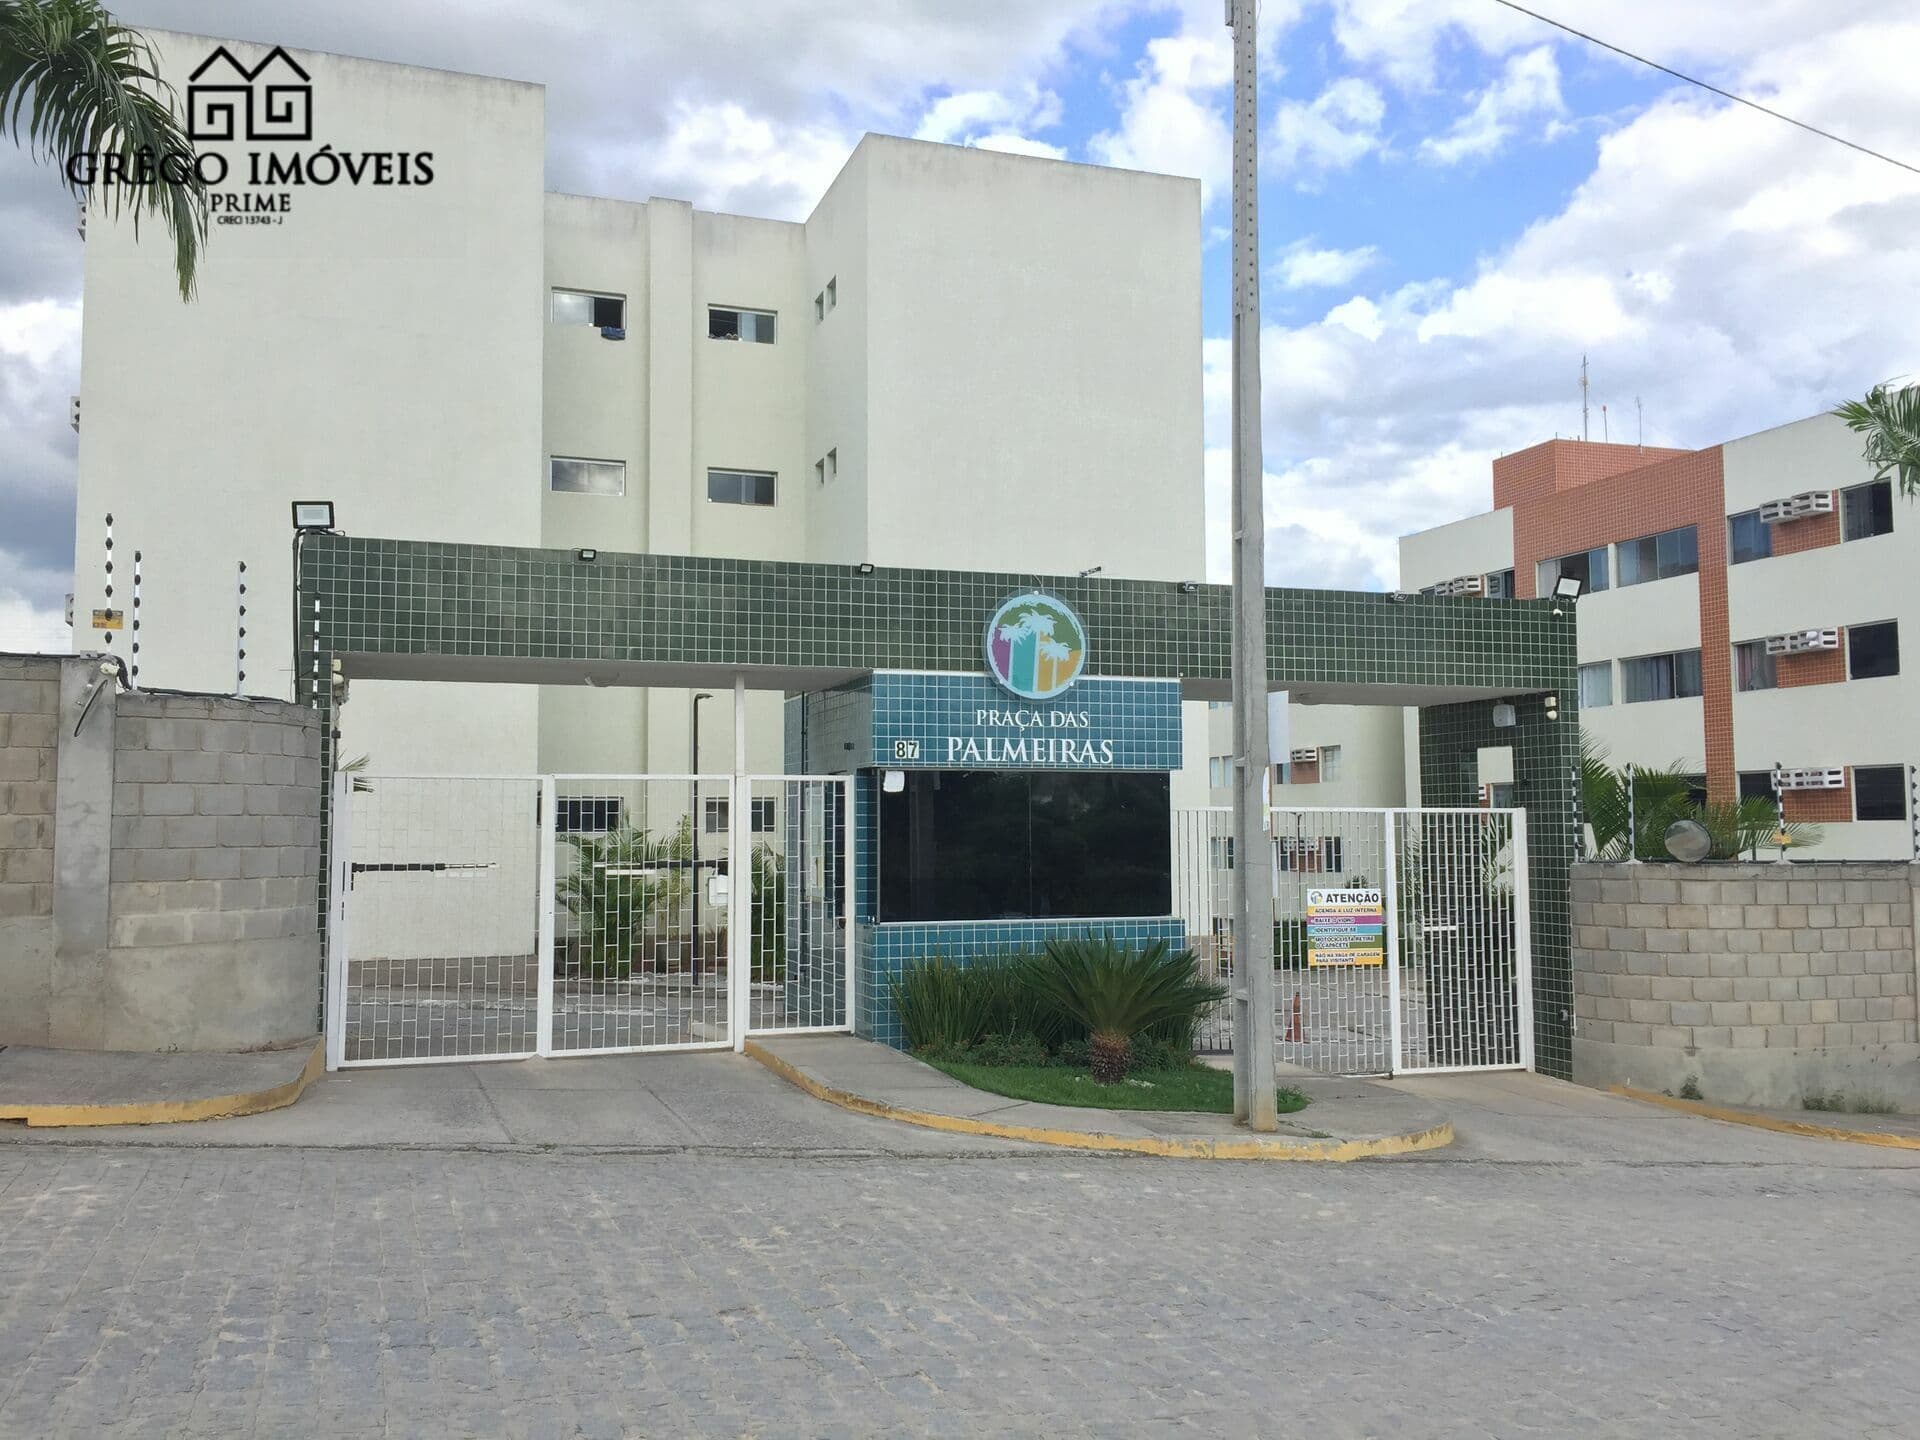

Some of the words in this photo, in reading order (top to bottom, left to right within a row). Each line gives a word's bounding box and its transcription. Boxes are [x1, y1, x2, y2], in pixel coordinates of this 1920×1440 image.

[976, 709, 1044, 730] PRAÇA
[1050, 711, 1089, 728] DAS
[895, 741, 918, 759] 87
[946, 737, 1113, 764] PALMEIRAS
[1326, 890, 1379, 905] ATENÇÃO
